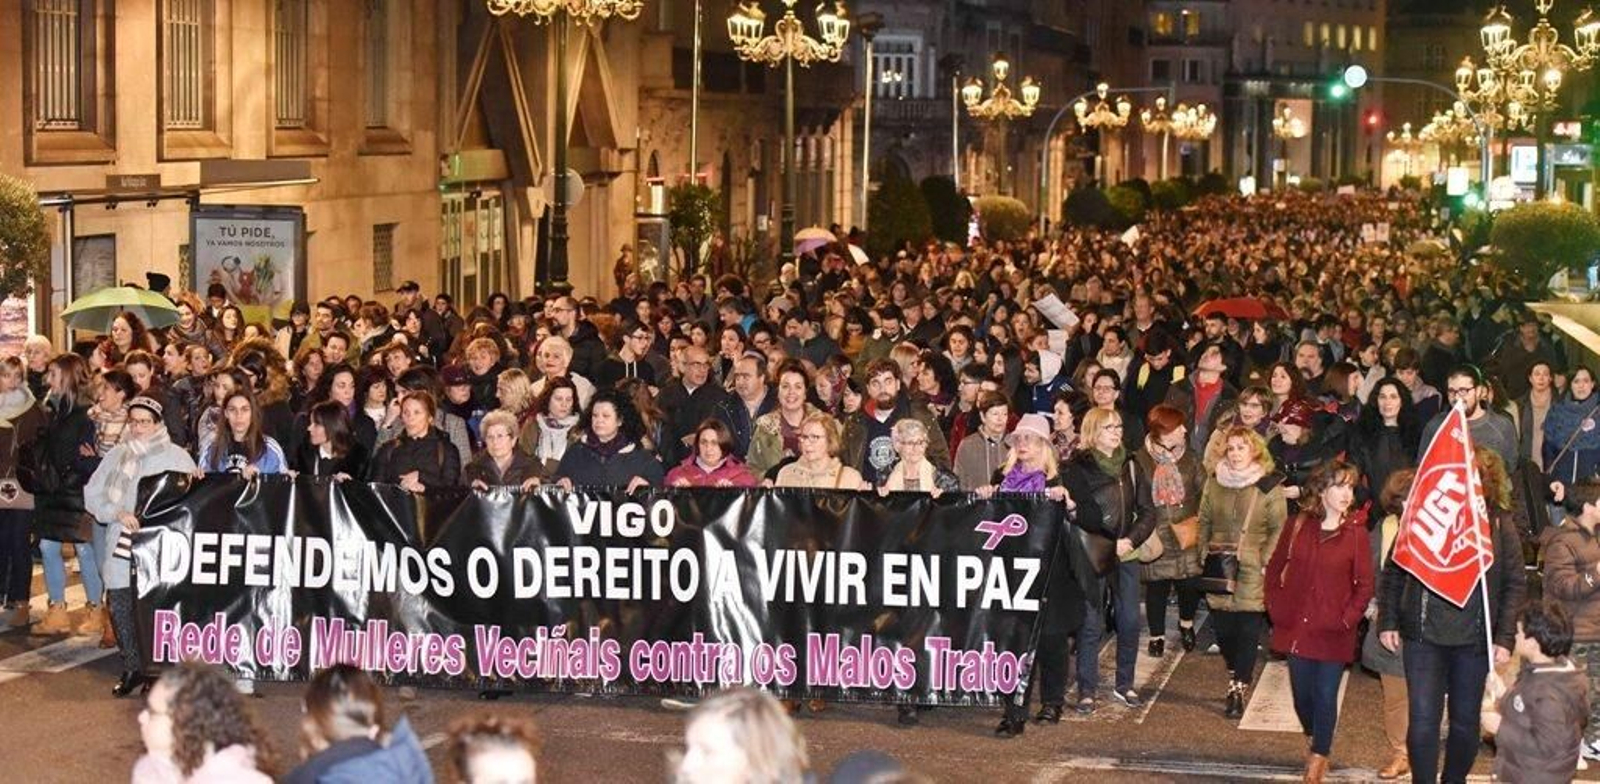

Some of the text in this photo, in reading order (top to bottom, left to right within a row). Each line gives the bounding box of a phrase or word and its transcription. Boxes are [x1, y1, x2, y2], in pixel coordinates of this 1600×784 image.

[219, 224, 275, 239] TÚ PIDE,
[569, 500, 676, 538] VIGO
[1411, 471, 1467, 556] UGT
[160, 532, 1041, 611] DEFENDEMOS O DEREITO A VIVIR EN PAZ
[152, 609, 243, 665] Rede
[255, 613, 303, 669] de
[313, 616, 466, 676] Mulleres
[474, 623, 621, 680] Veciñais
[629, 633, 743, 688] contra
[752, 642, 797, 687] os
[807, 633, 917, 690] Malos
